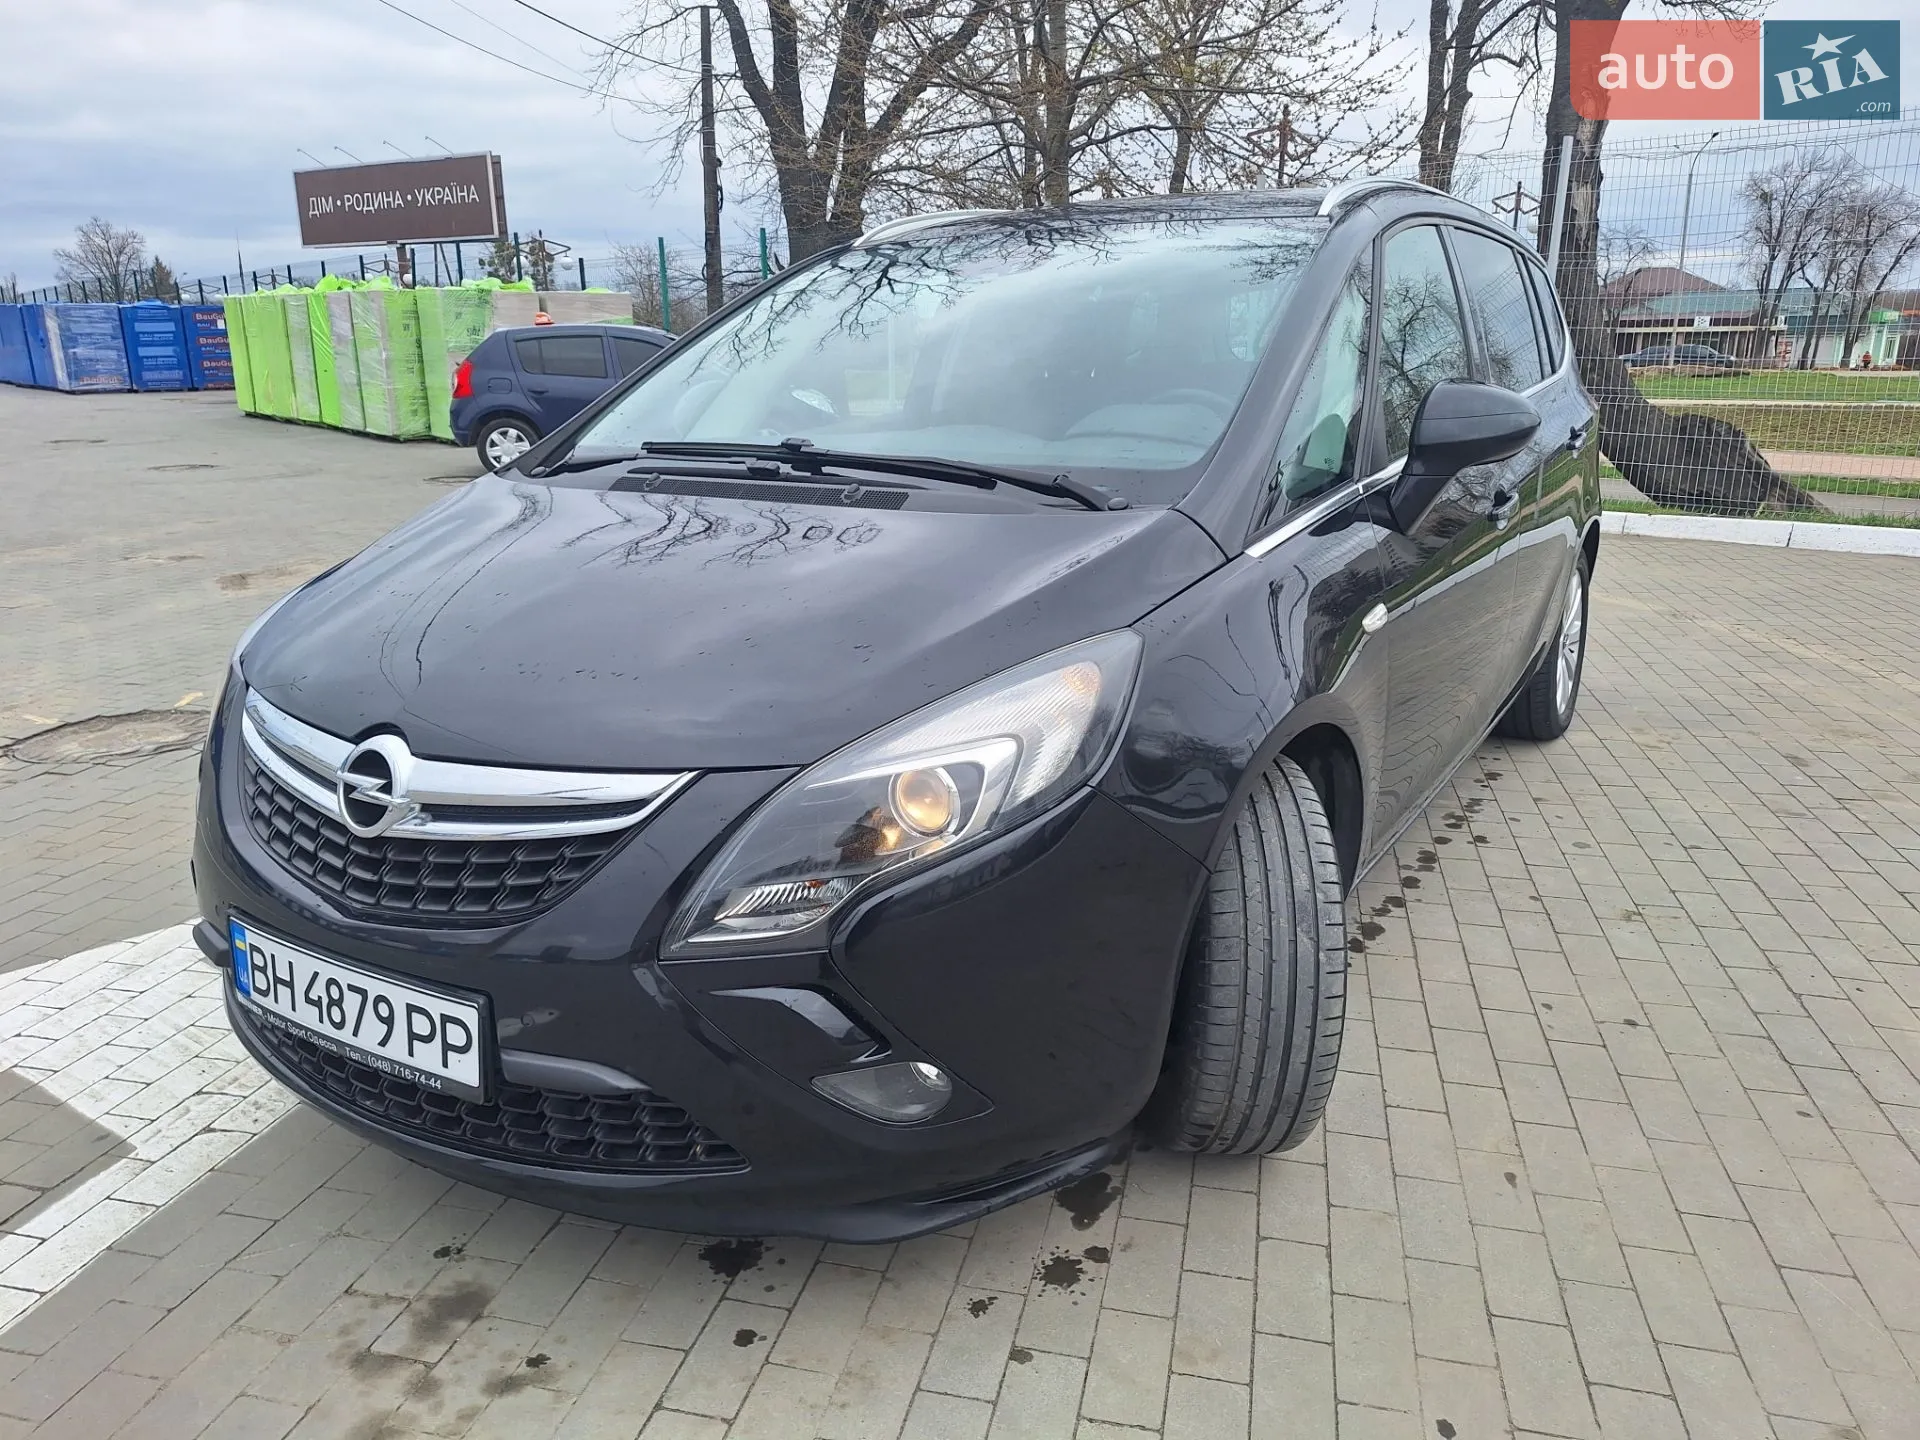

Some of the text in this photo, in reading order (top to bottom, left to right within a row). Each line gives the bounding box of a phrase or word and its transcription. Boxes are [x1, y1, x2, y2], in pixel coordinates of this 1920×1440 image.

[309, 182, 480, 219] ДІМ РОДИНА УКРАЇНА
[249, 942, 473, 1069] BH 4879 PP
[367, 1054, 391, 1073] (048)
[393, 1064, 442, 1090] 716-74-44
